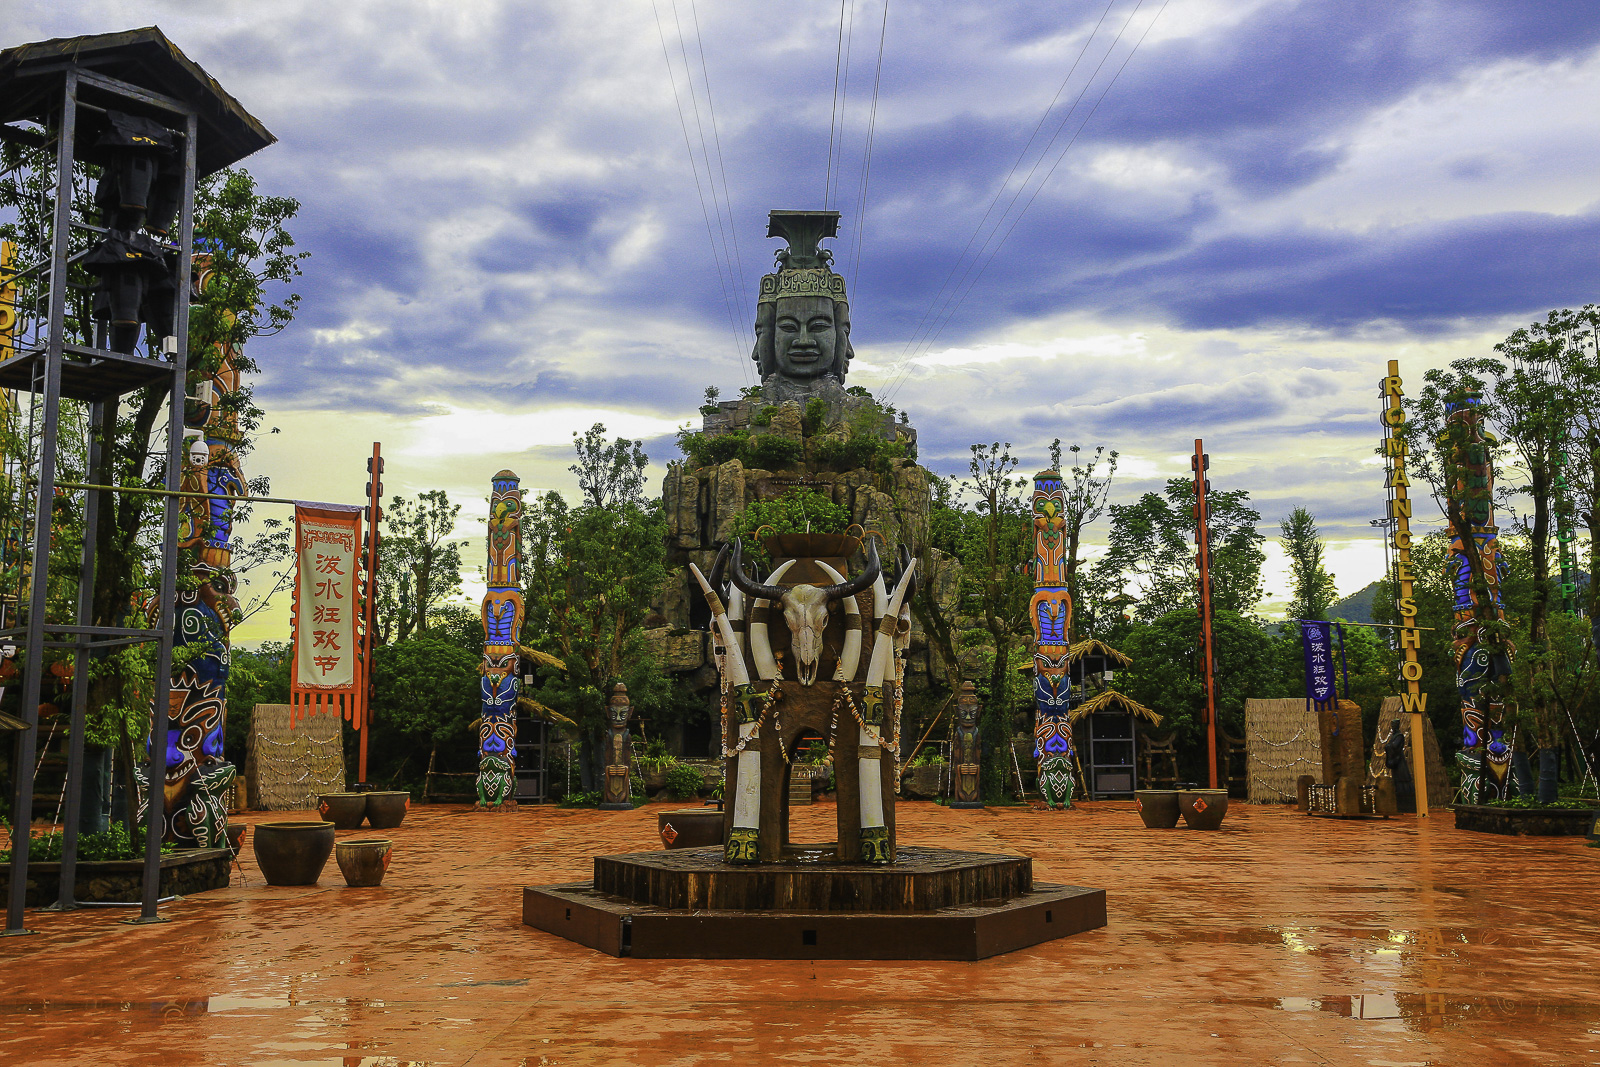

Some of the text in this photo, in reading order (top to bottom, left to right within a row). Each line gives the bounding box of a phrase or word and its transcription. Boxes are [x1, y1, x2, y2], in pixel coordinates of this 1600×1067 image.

[312, 553, 345, 677] 泼水狂欢节
[1311, 642, 1329, 698] 泼水狂欢节
[1399, 596, 1428, 713] SHOW
